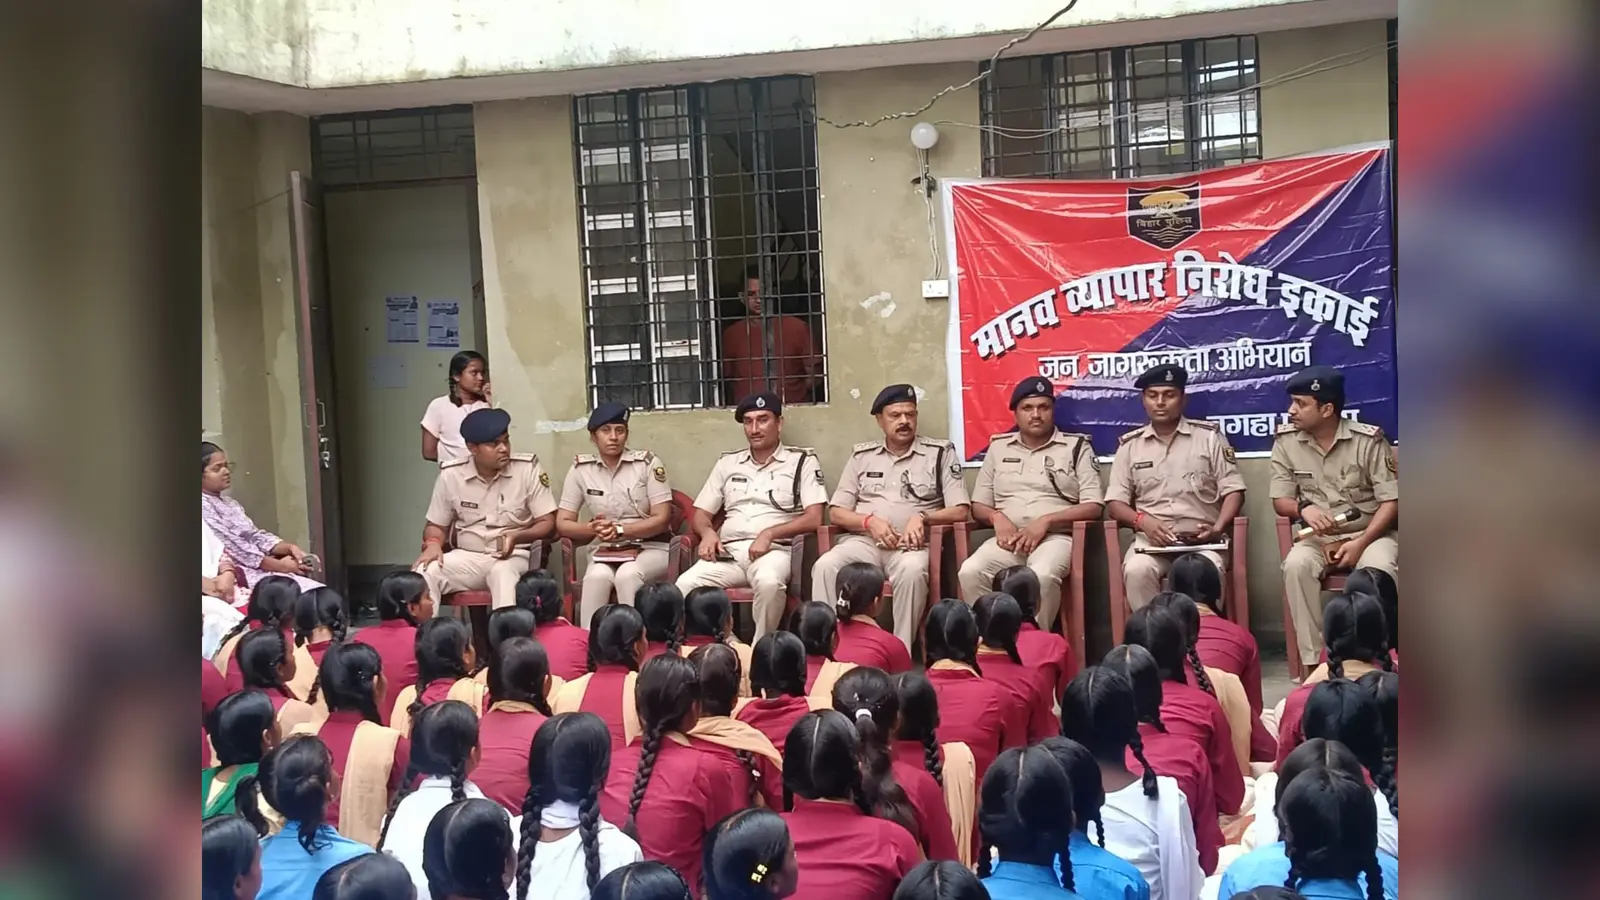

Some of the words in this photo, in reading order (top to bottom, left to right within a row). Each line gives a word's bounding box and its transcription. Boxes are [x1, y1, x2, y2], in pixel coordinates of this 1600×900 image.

[1136, 218, 1161, 228] बिहार
[1165, 216, 1193, 229] पुलिस
[970, 288, 1060, 358] मानव
[1060, 262, 1168, 313] व्यापार
[1172, 249, 1273, 306] निरोध
[1278, 273, 1379, 346] इकाई
[1038, 355, 1079, 379] जन
[1215, 338, 1312, 371] अभियान
